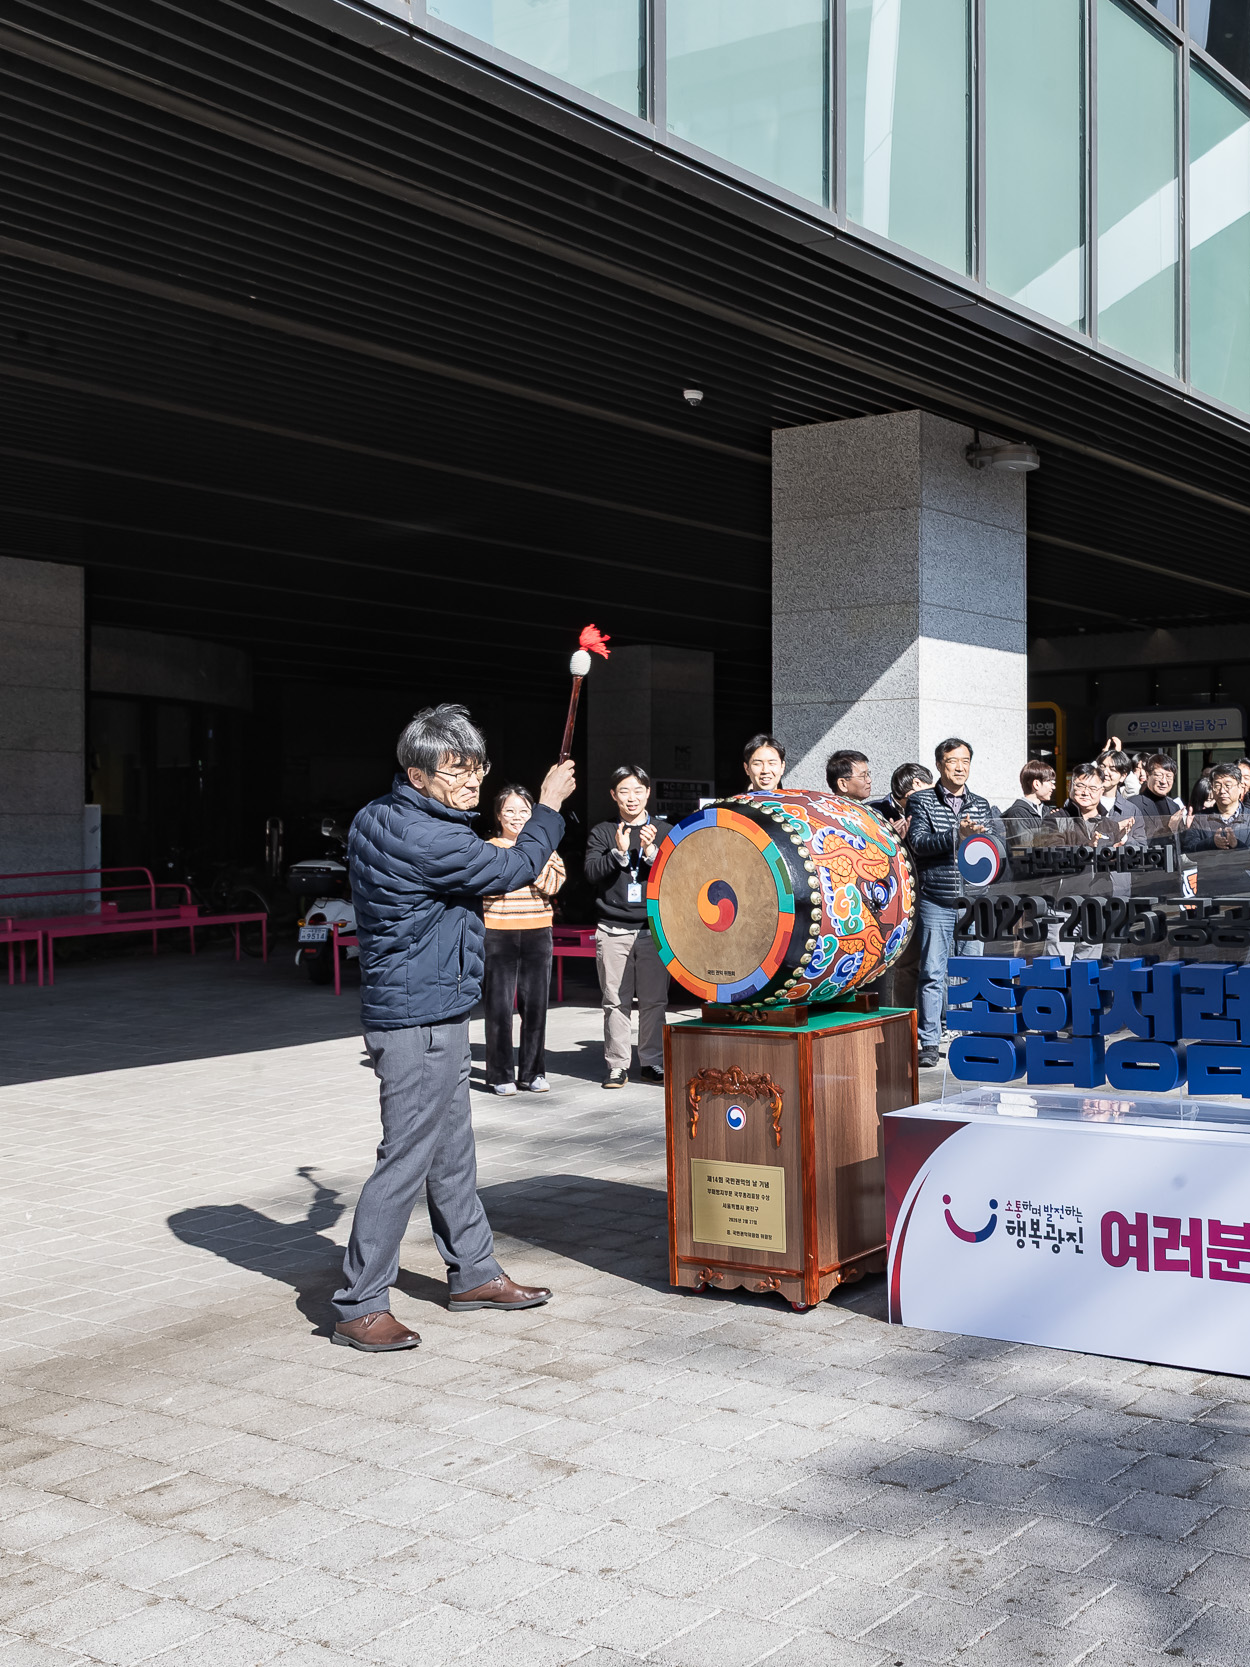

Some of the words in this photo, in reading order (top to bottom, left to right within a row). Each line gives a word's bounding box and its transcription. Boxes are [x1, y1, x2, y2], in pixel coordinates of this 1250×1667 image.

[1139, 719, 1227, 733] 무인민원발급창구
[1004, 1200, 1042, 1218] 소통하며
[1043, 1204, 1084, 1223] 발전하는
[1005, 1218, 1085, 1255] 행복광진
